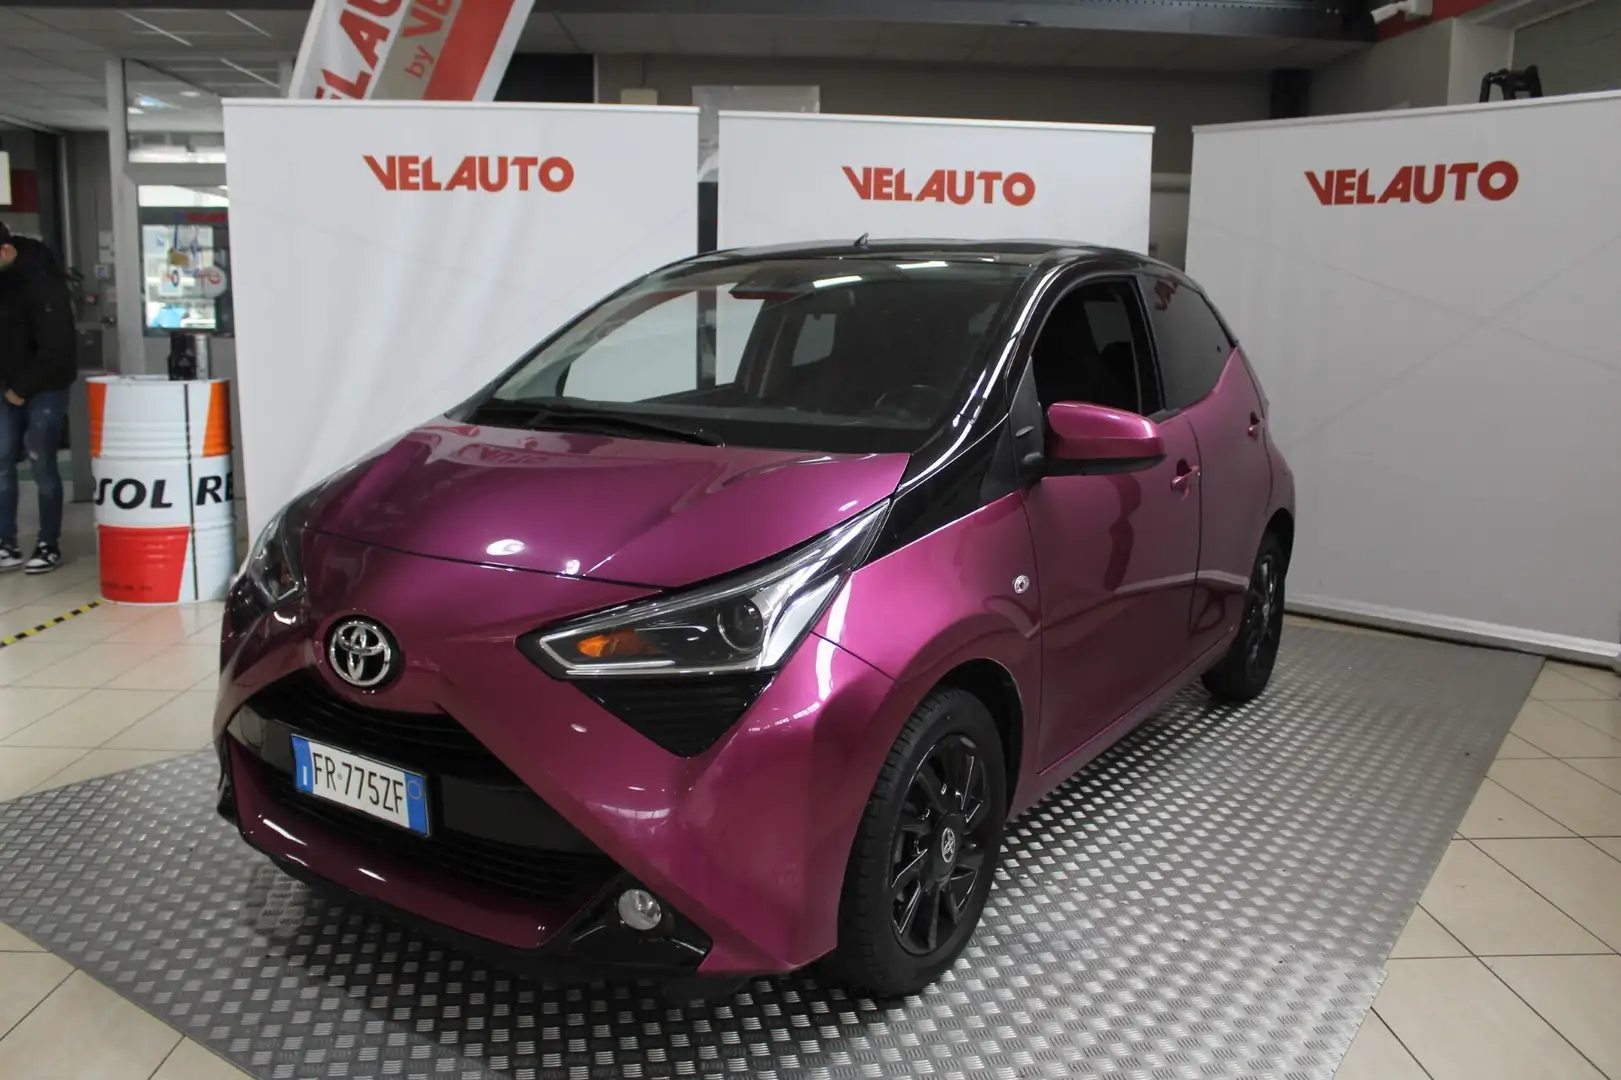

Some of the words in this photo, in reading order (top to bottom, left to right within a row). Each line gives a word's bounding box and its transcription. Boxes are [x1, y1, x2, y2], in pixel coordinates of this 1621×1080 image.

[403, 44, 435, 79] by
[362, 155, 574, 192] VELAUTO
[841, 165, 1036, 206] VELAUTO
[1303, 160, 1519, 205] VELAUTO
[93, 476, 173, 510] SOL
